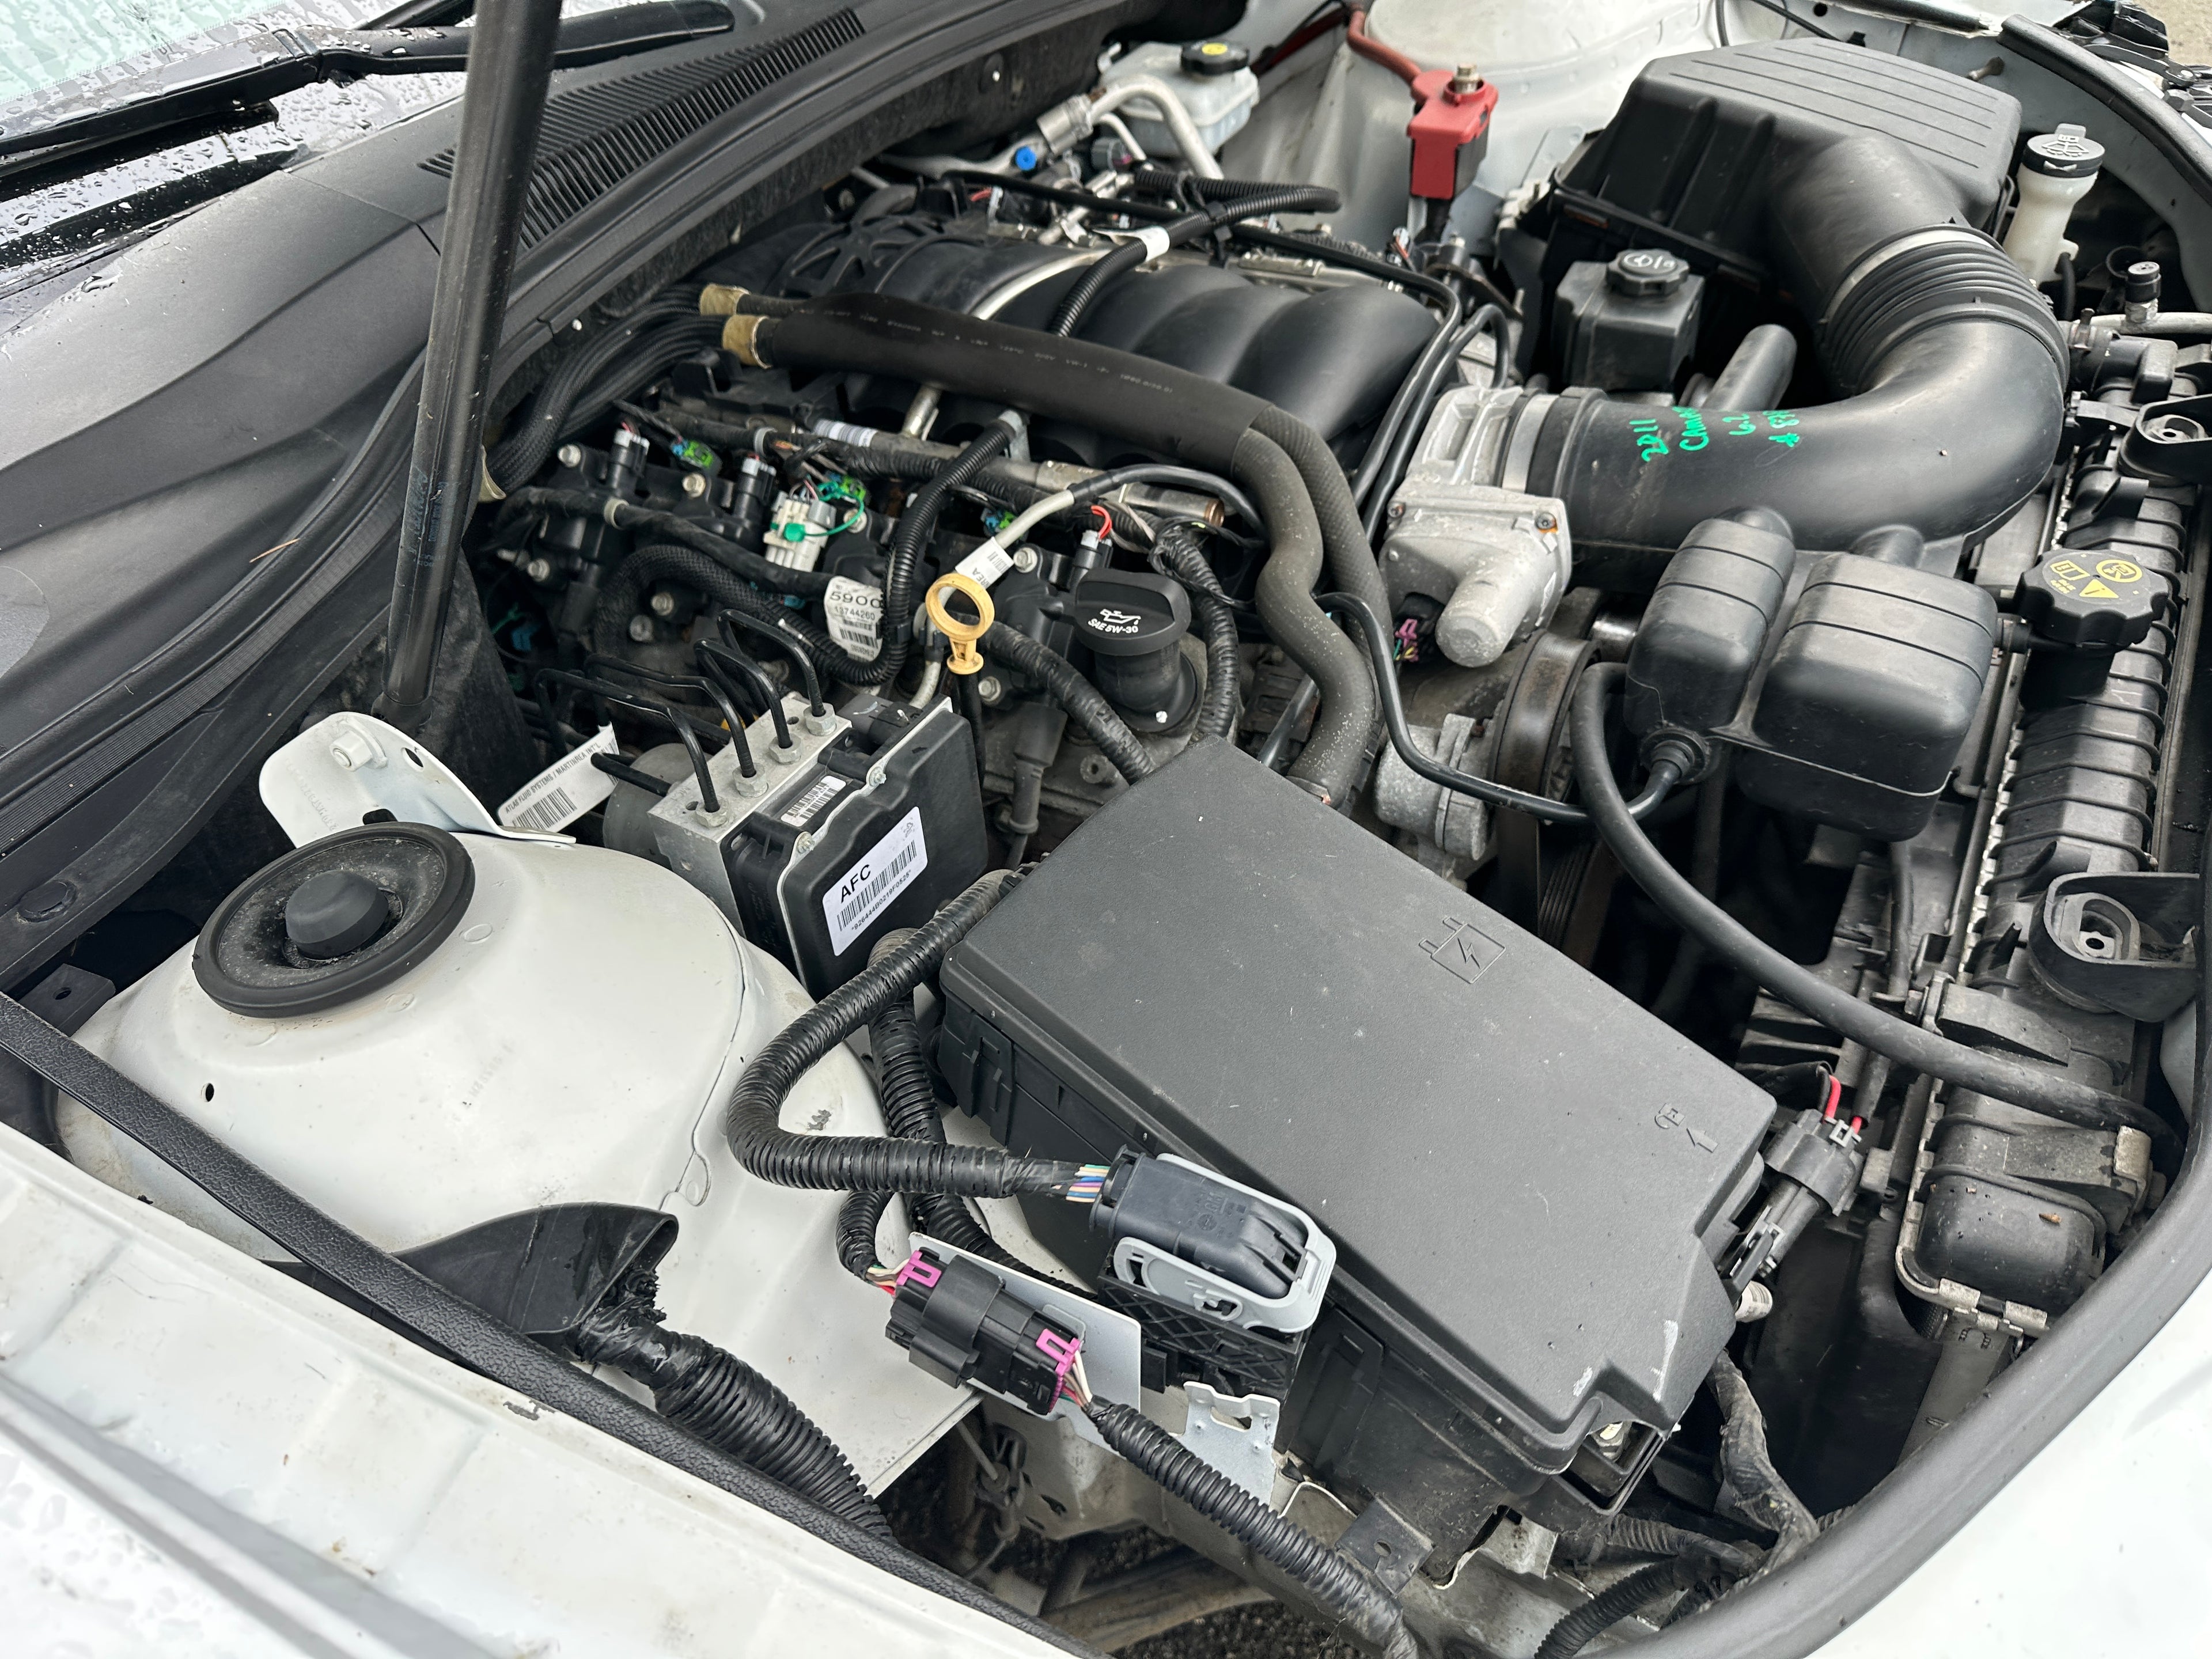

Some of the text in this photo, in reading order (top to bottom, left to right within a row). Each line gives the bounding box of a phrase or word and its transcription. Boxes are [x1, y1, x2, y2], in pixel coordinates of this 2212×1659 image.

[1629, 419, 1669, 461] 2011
[830, 591, 881, 608] 5900
[1088, 618, 1139, 634] SAE 5W-30
[505, 797, 520, 813] ATLAS
[519, 789, 532, 804] FLUID
[531, 774, 554, 793] SYSTEMS
[555, 752, 587, 775] MARTINREA
[840, 864, 871, 903] AFC
